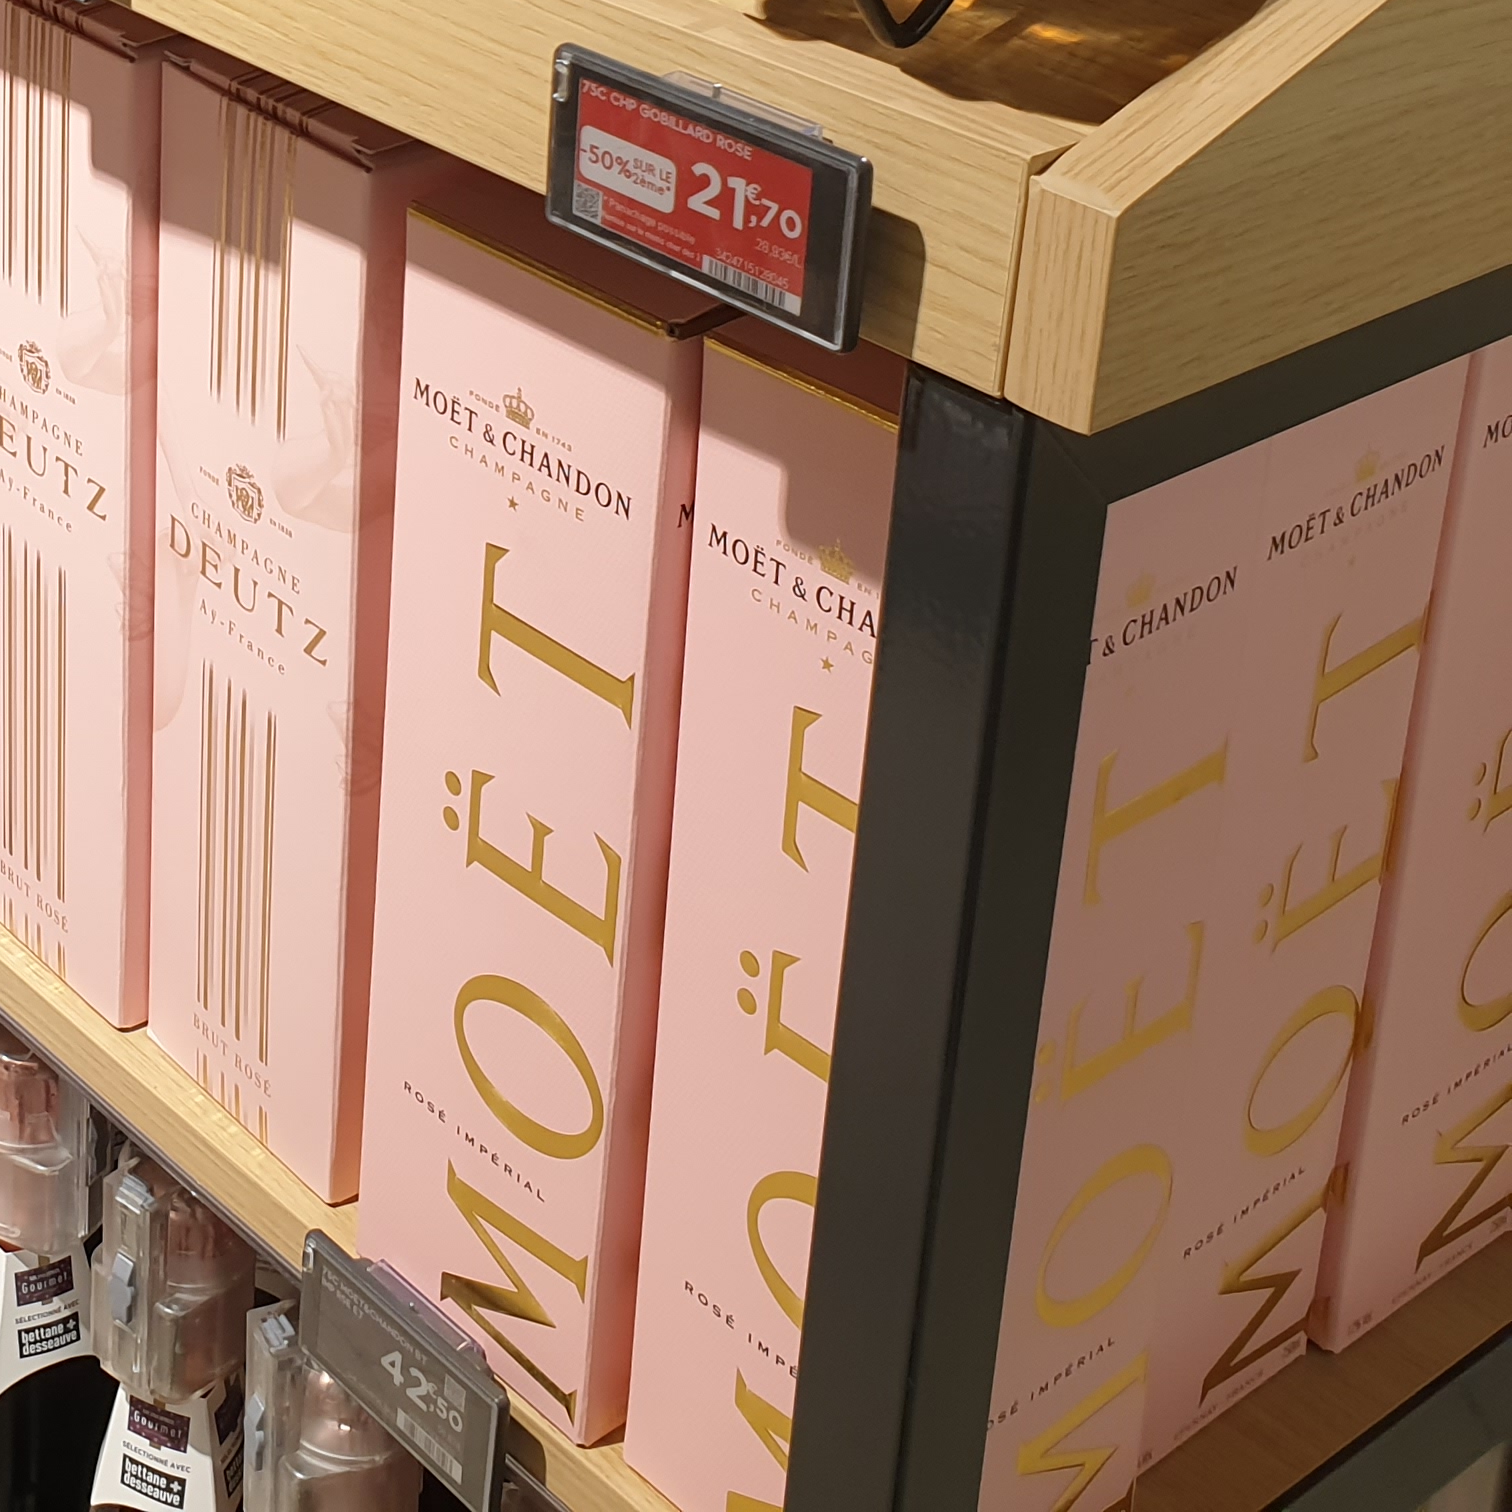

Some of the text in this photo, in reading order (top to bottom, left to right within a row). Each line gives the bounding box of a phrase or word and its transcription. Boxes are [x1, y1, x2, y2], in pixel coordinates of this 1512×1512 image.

[580, 78, 754, 162] 75C CHP GOBILLARD ROSE
[579, 142, 674, 185] -50% SUR LE
[412, 376, 633, 522] MOËT & CHANDON
[1482, 414, 1512, 450] MO
[448, 433, 586, 523] CHAMPAGNE
[1266, 444, 1446, 563] MOËT & CHANDON
[167, 512, 328, 668] DEUTZ
[189, 500, 302, 596] CHAMPAGNE
[707, 522, 879, 640] MOËT & CHA
[749, 587, 874, 667] CHAMPAG
[1121, 564, 1239, 649] CHANDON
[0, 858, 69, 934] BRUT ROSÉ
[440, 540, 638, 1428] MOËT
[191, 1011, 272, 1099] BRUT ROSÉ
[402, 1078, 547, 1204] ROSÉ IMPÉRIAL
[1400, 1091, 1441, 1127] ROSÉ
[1182, 1165, 1307, 1261] ROSÉ IMPÉRIAL
[20, 1270, 69, 1296] Gourmet
[20, 1321, 65, 1345] bettane
[20, 1329, 79, 1358] desseauve
[683, 1279, 799, 1378] ROSÉ IMPÉ
[133, 1407, 186, 1439] Gourmet
[986, 1335, 1117, 1431] OSÉ IMPÉRIAL
[122, 1468, 182, 1508] desseauve
[123, 1456, 168, 1490] bettane
[168, 1461, 192, 1474] AVEC
